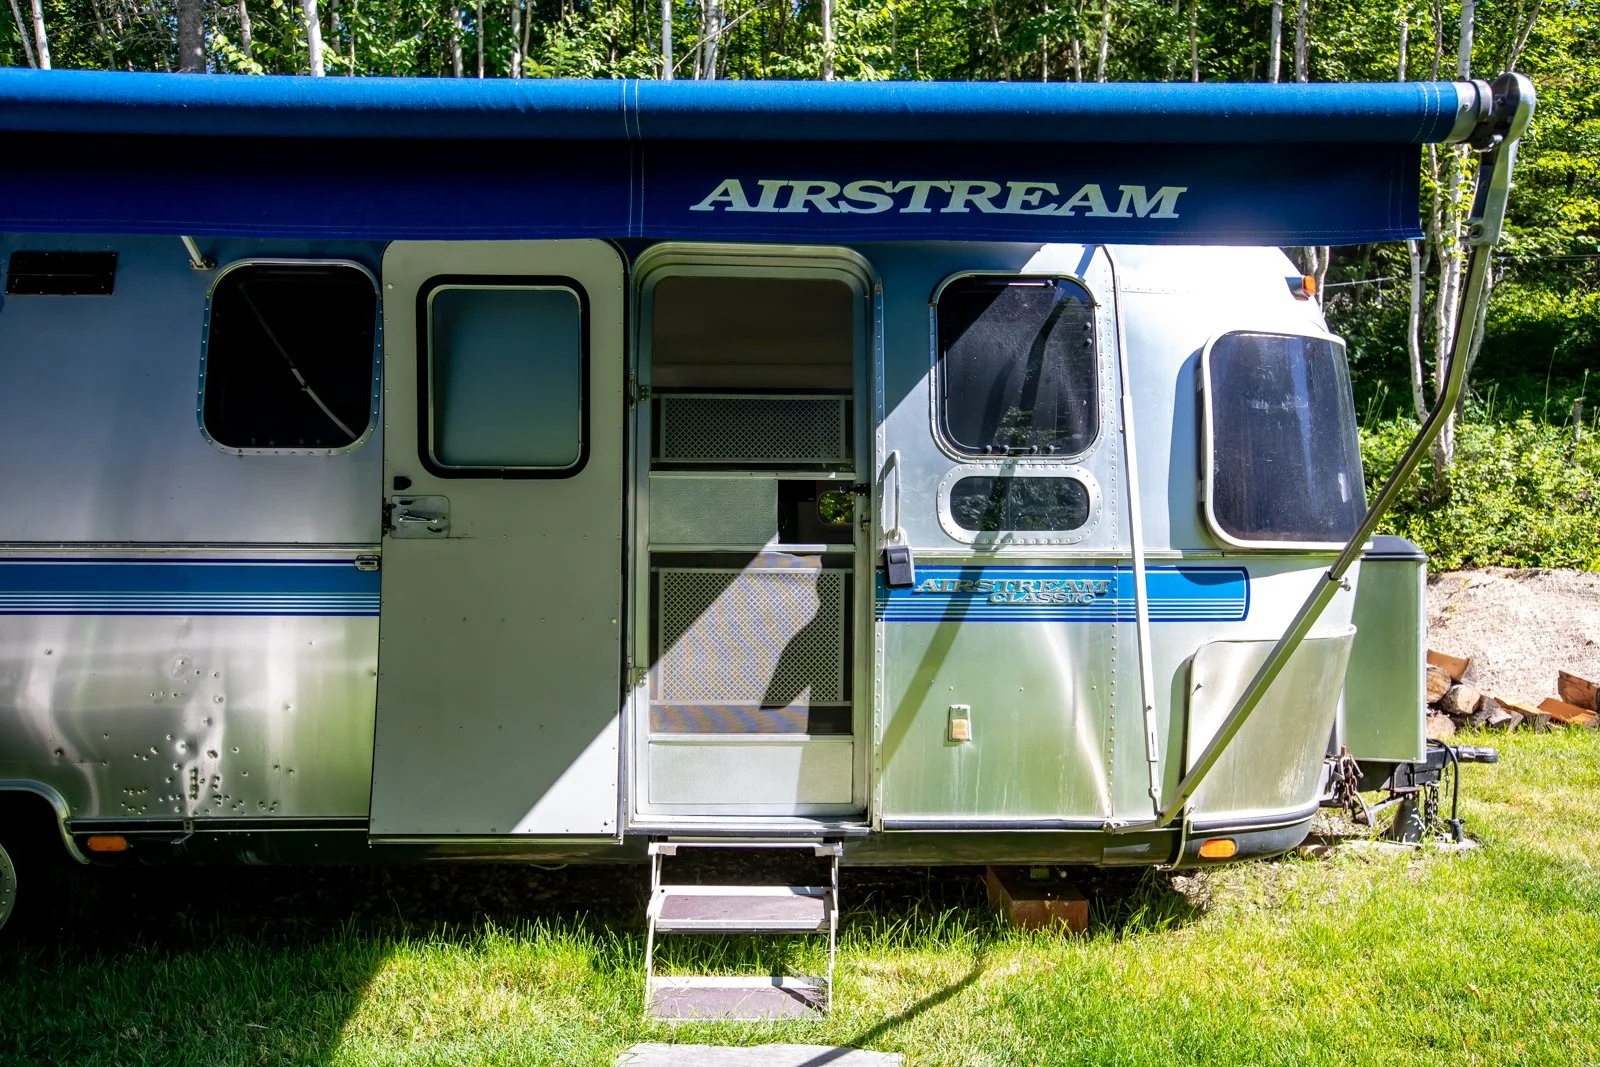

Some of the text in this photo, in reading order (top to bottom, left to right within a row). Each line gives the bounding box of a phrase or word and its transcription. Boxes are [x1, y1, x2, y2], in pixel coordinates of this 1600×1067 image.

[689, 178, 1188, 218] AIRSTREAM
[914, 579, 1111, 594] AIRSTREAM
[988, 592, 1096, 605] CLASSIC
